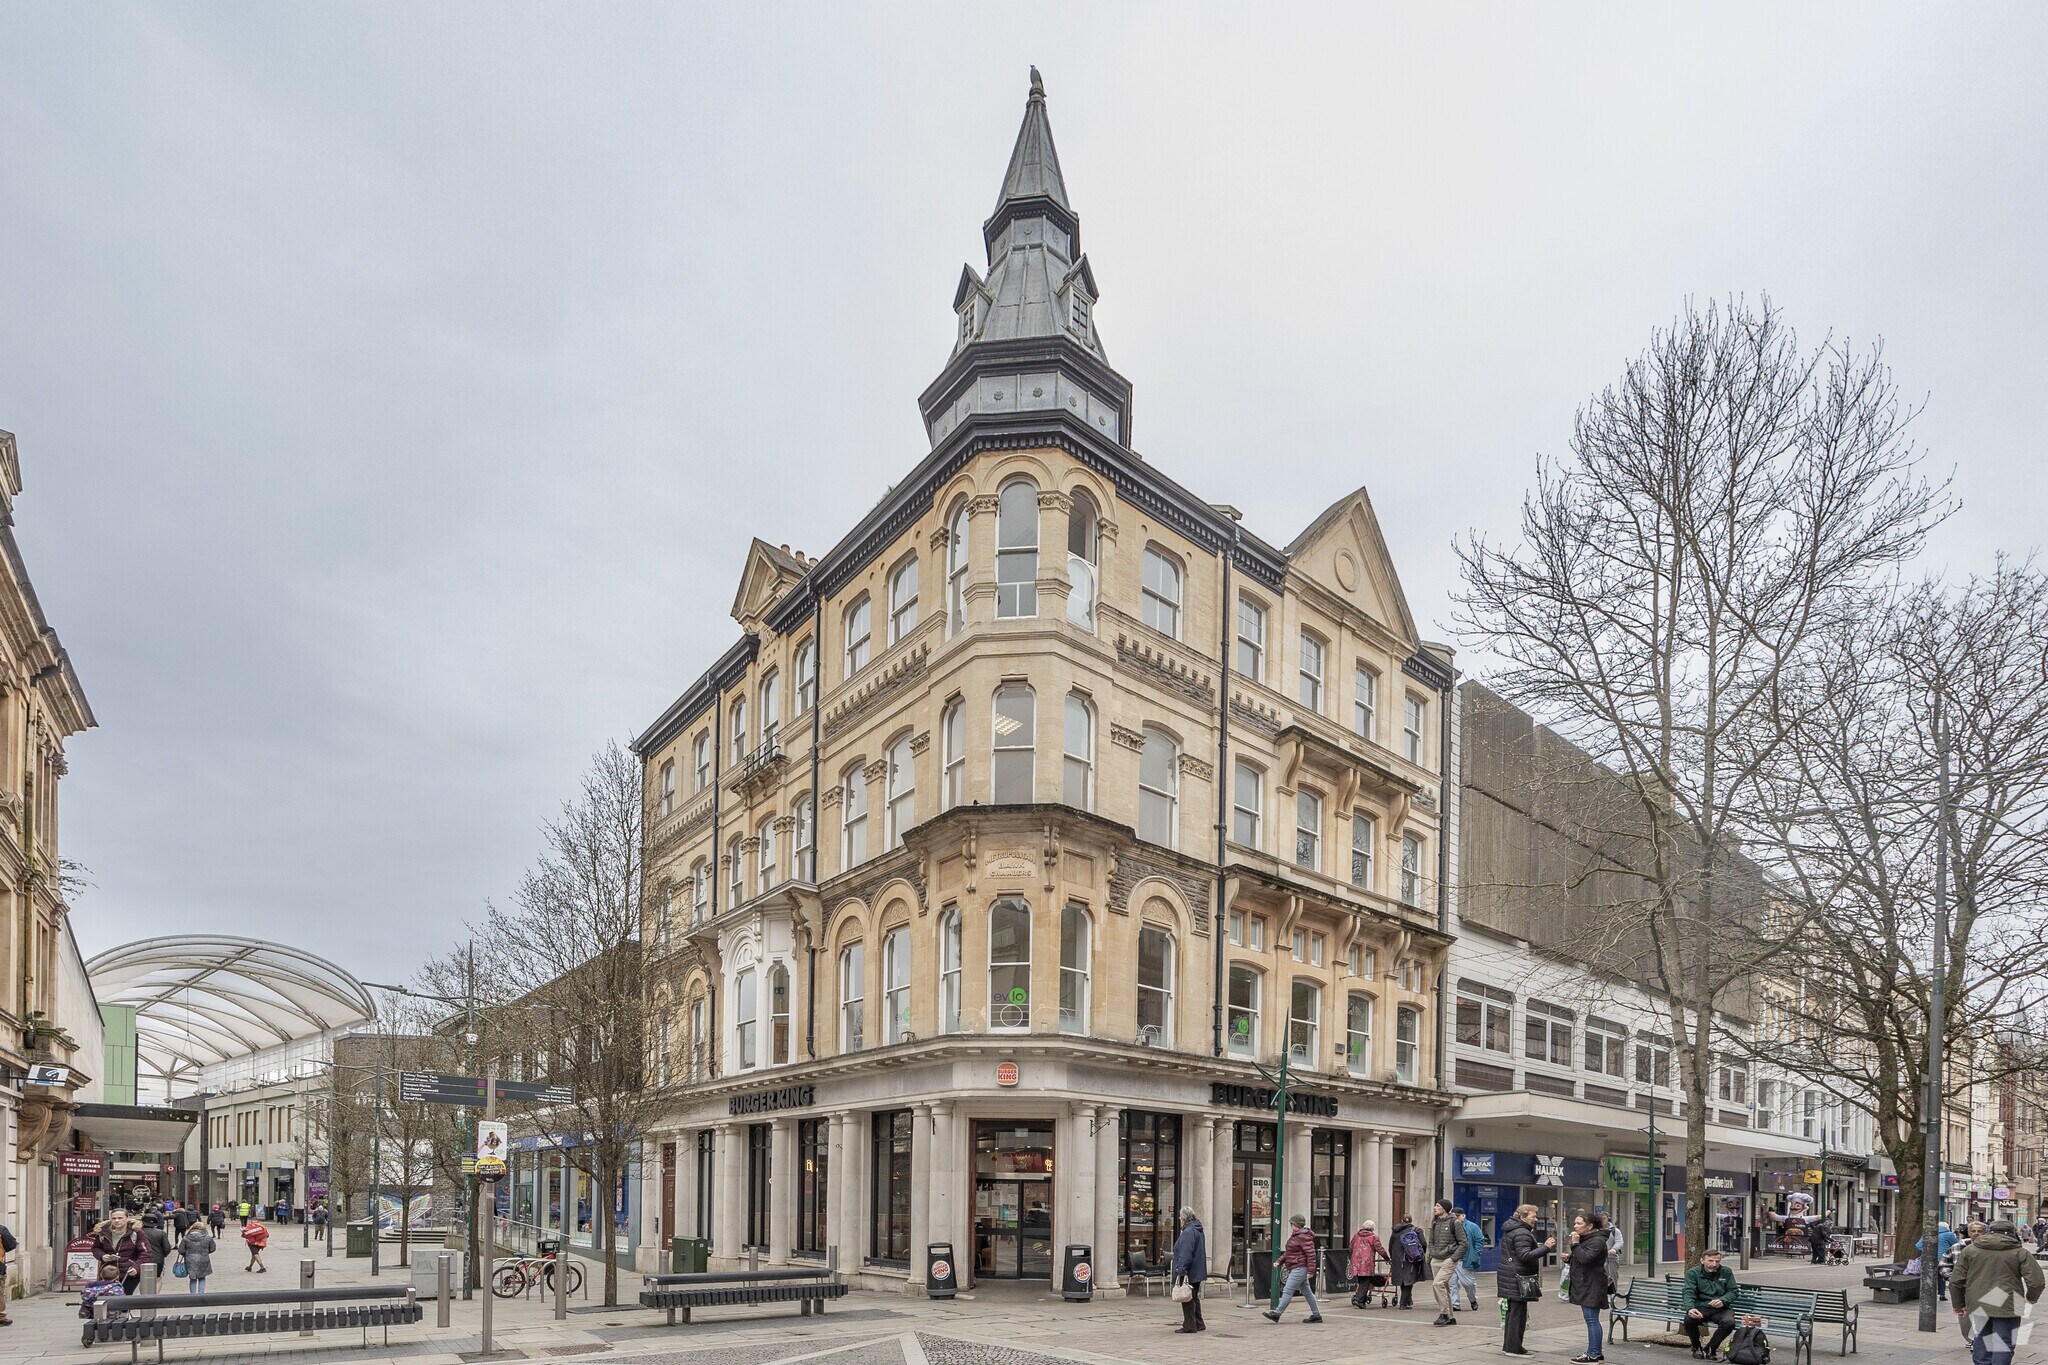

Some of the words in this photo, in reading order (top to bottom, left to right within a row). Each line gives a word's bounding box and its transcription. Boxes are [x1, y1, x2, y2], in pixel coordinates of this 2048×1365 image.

[985, 851, 1036, 866] METROPOLITAN
[729, 1091, 777, 1115] BURGER
[777, 1085, 811, 1109] KING
[1212, 1082, 1295, 1112] BURGER
[1295, 1092, 1339, 1117] KING
[1535, 1164, 1564, 1177] HALIFAX
[1705, 1176, 1723, 1189] perative
[1724, 1177, 1734, 1189] bank
